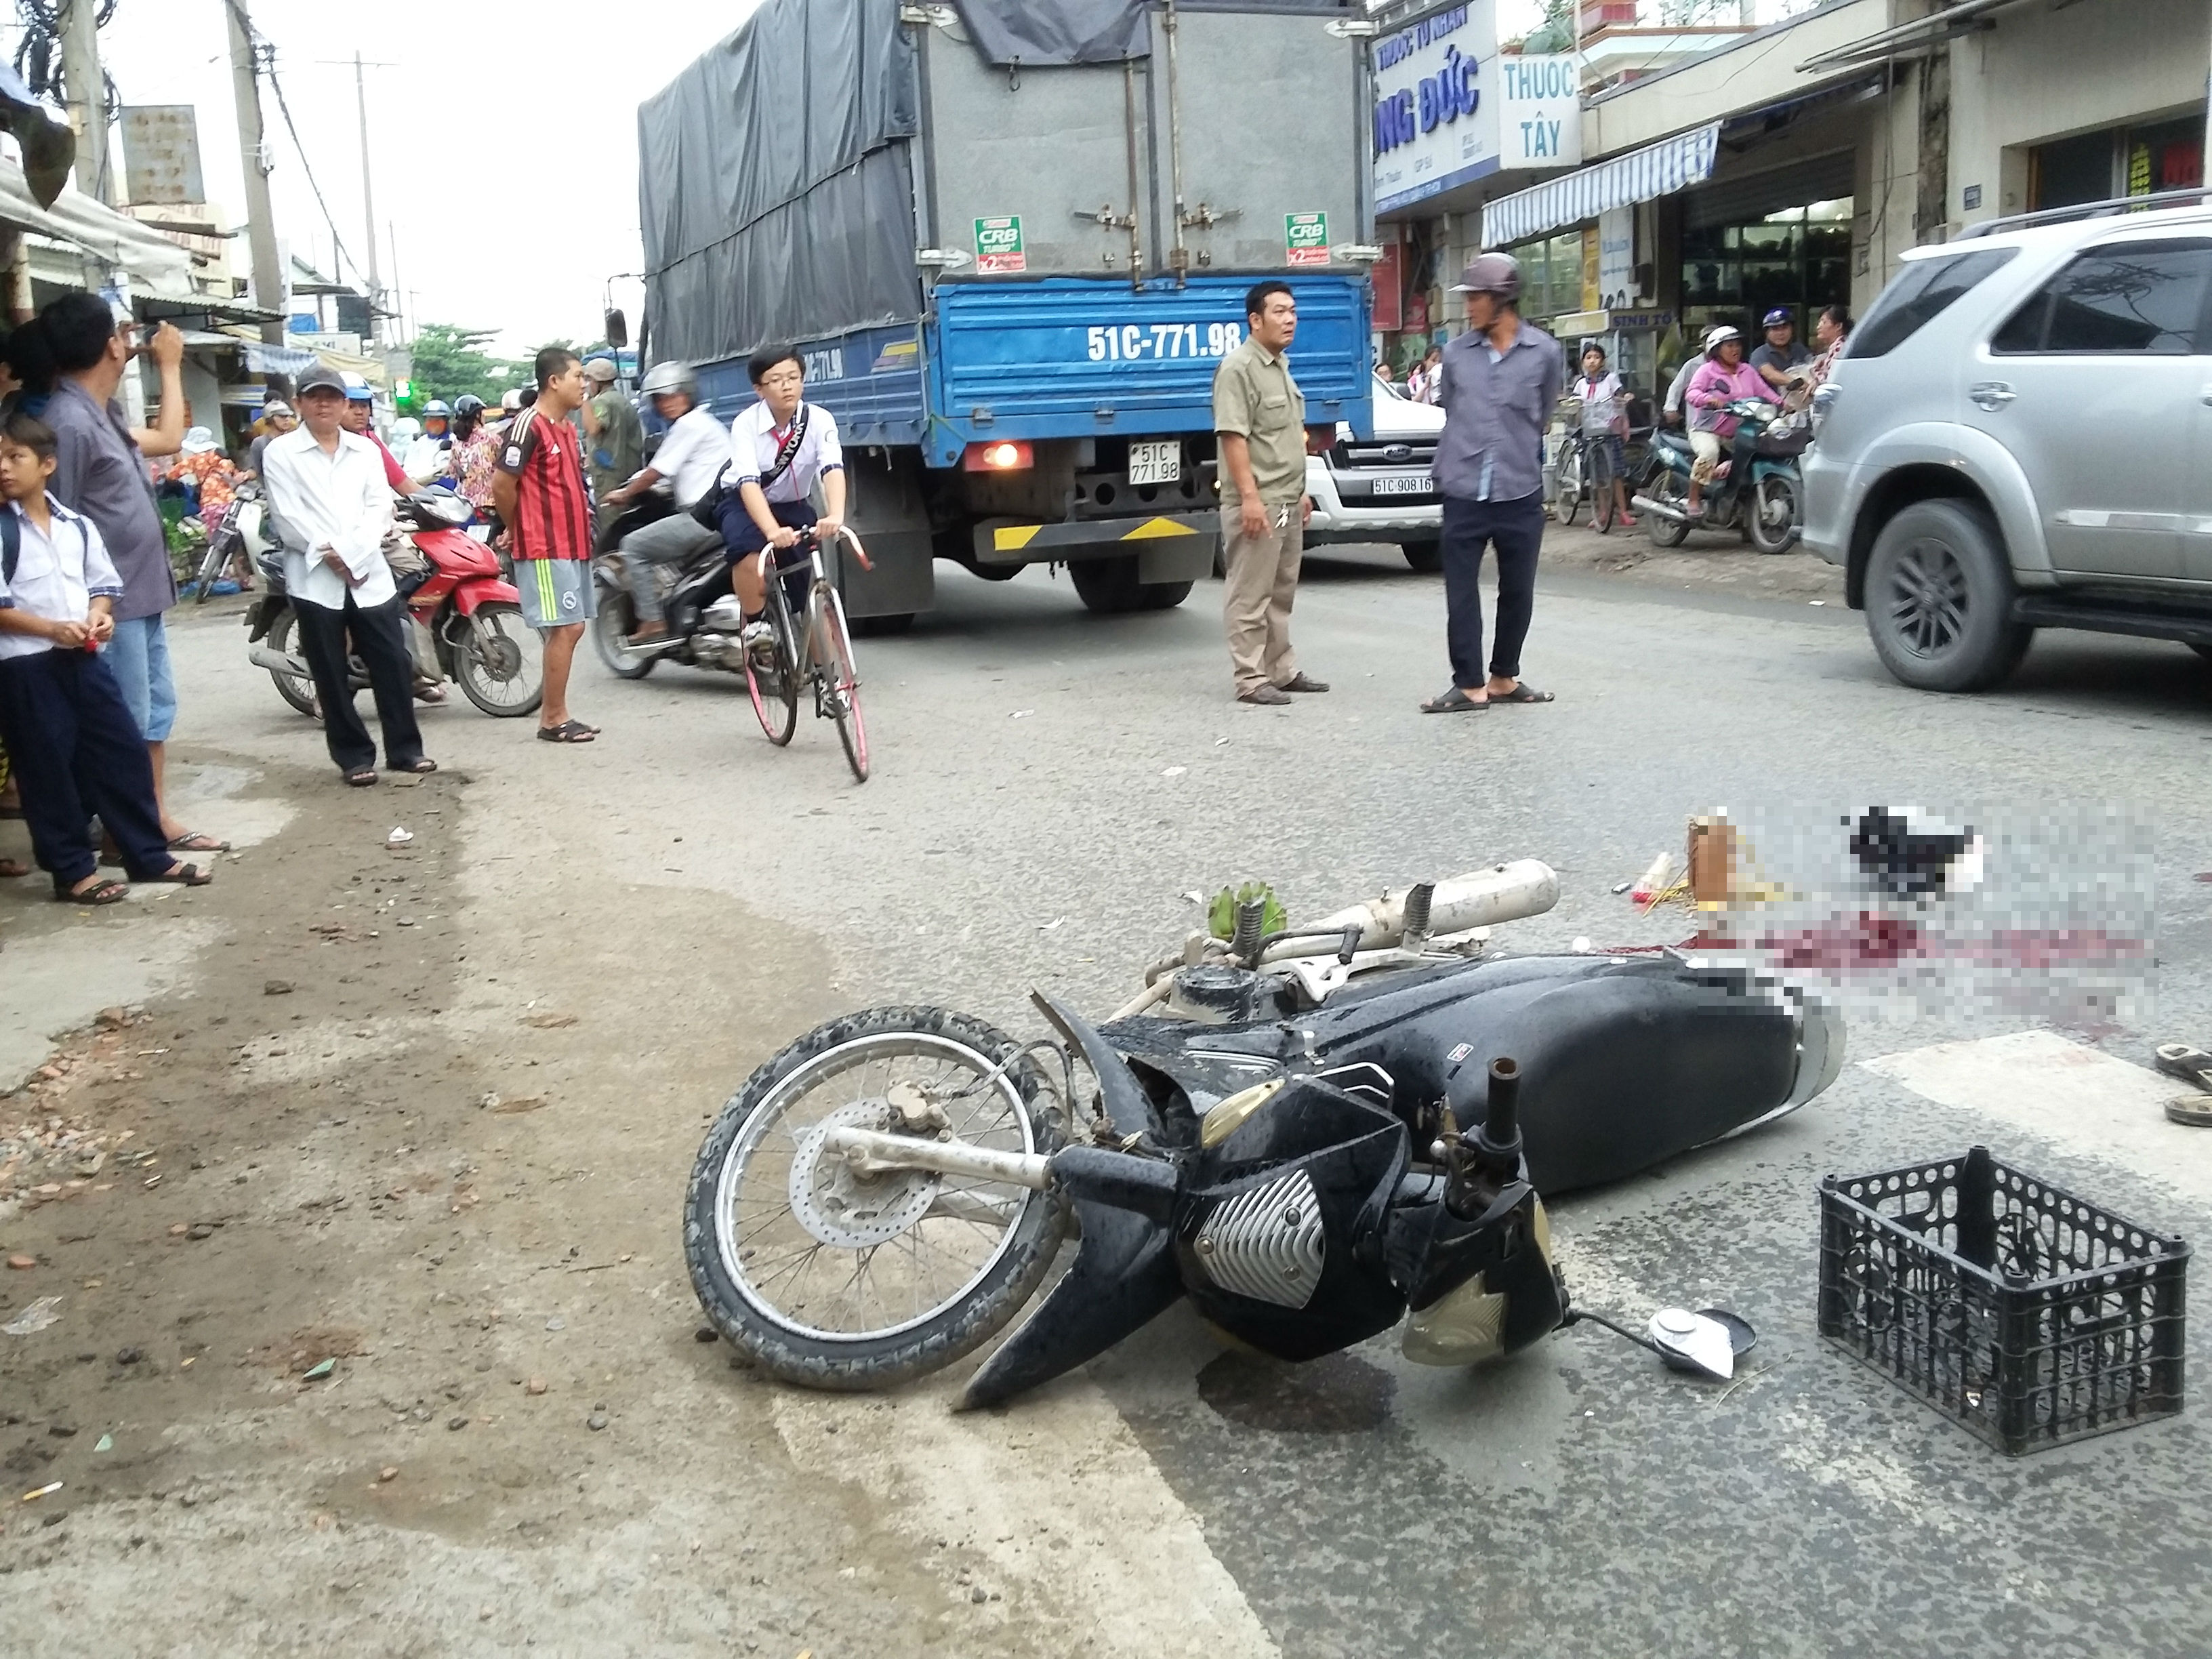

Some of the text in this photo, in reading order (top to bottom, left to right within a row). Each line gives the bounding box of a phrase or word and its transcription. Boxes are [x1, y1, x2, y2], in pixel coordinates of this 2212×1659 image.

[1373, 44, 1479, 160] NG ĐỨC
[1521, 110, 1561, 157] TÂY
[979, 228, 1019, 245] CRB
[1289, 223, 1324, 239] CRB
[1088, 322, 1242, 361] 51C-771.98
[1141, 444, 1168, 462] 51C
[1375, 479, 1394, 492] 51C
